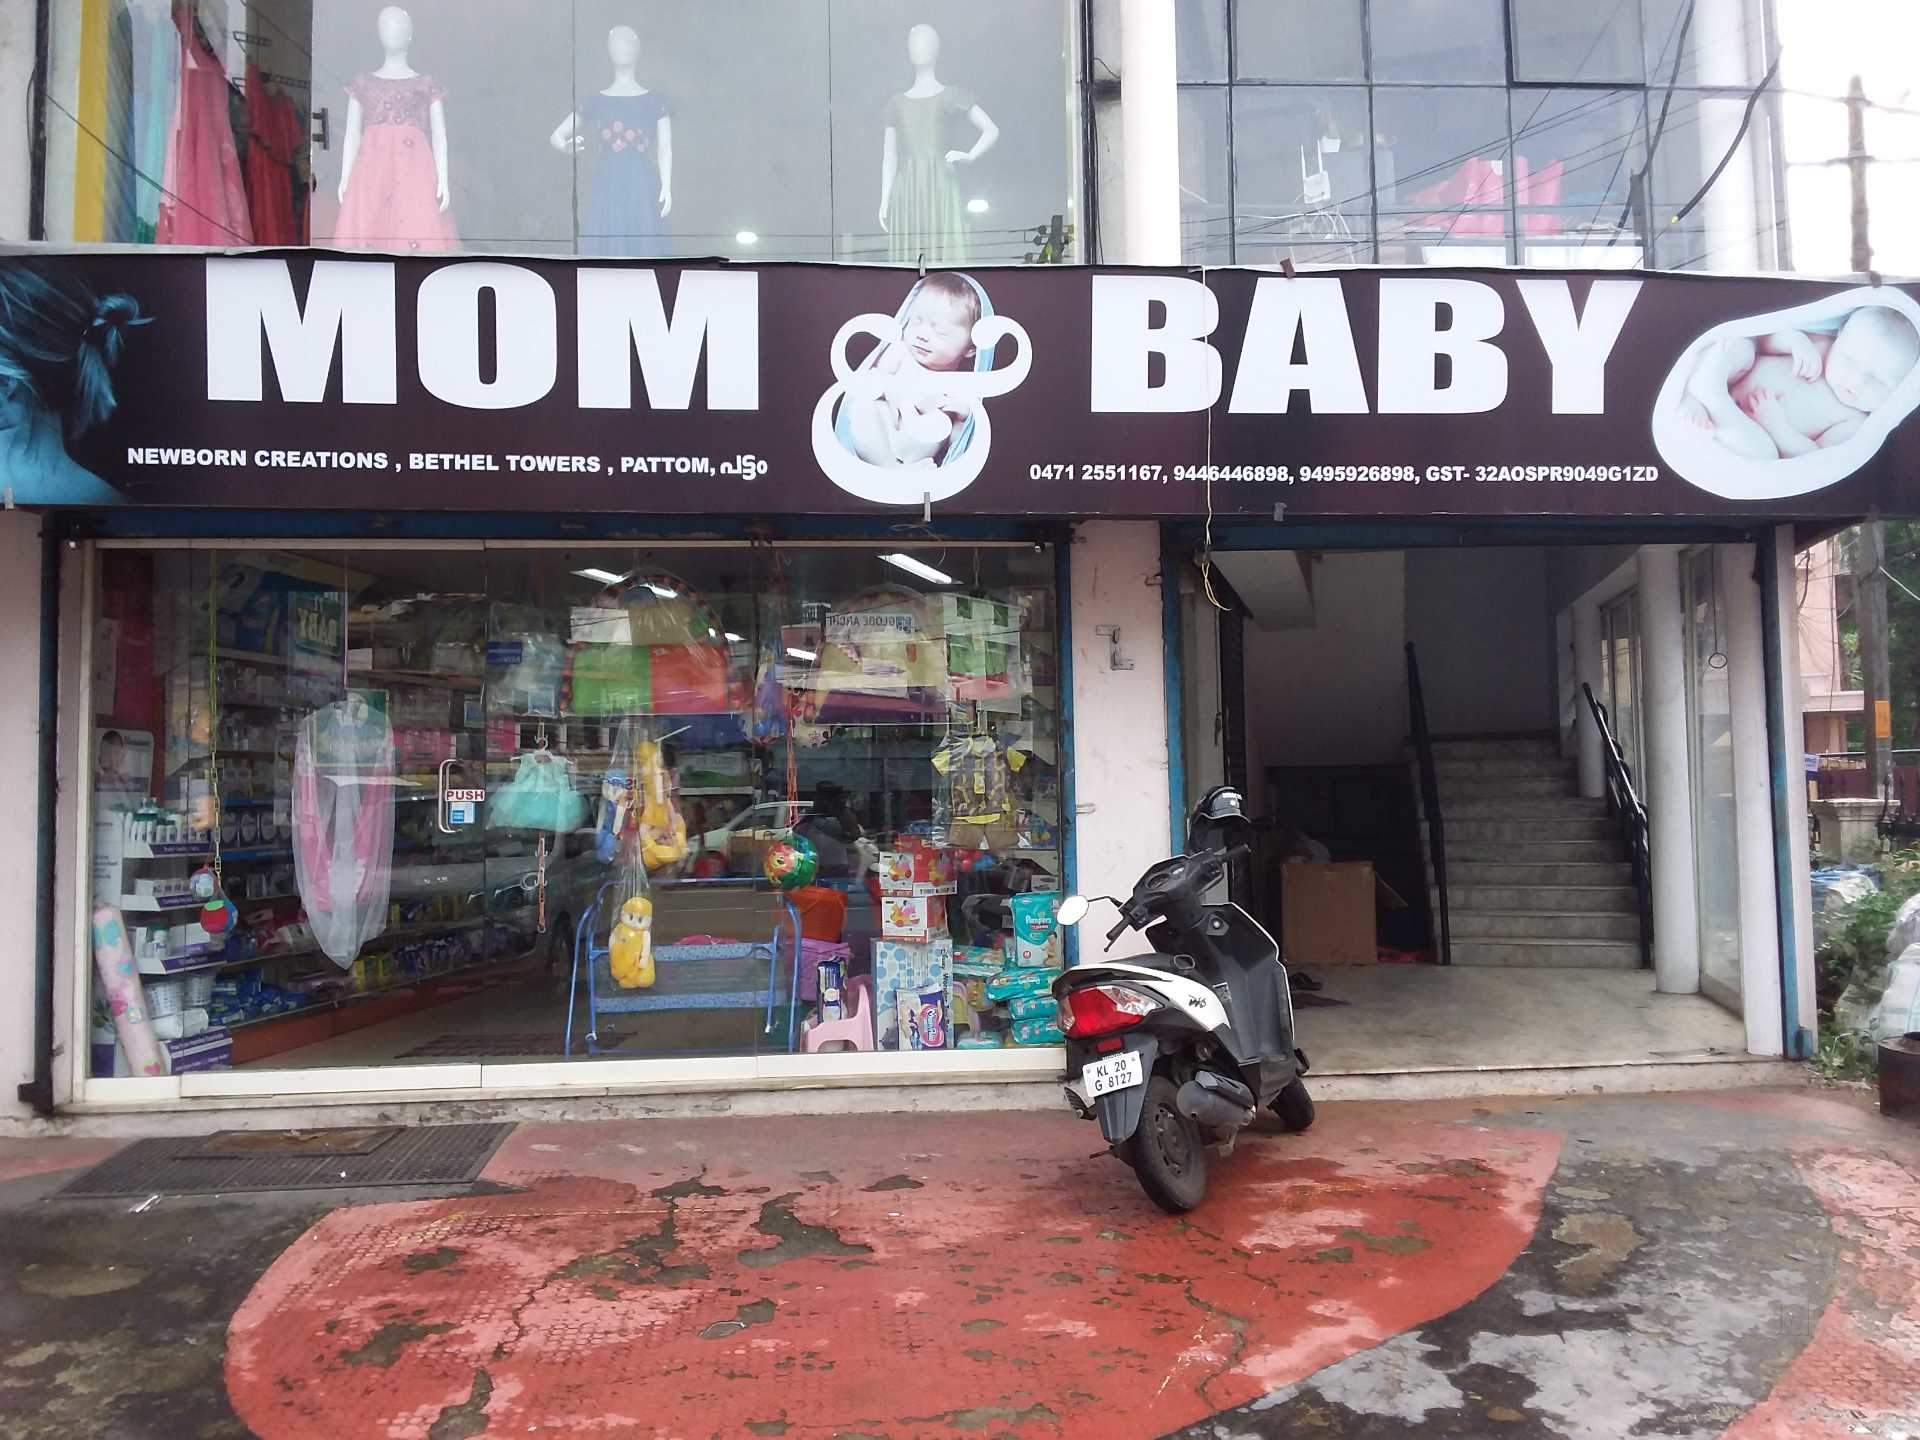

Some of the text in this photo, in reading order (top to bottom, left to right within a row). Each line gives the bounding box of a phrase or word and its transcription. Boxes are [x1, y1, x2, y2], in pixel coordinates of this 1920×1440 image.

[206, 257, 759, 410] MOM
[1091, 275, 1643, 414] BABY
[128, 448, 247, 466] NEWBORN
[254, 451, 388, 469] CREATIONS
[409, 453, 499, 471] BETHEL
[505, 455, 601, 472] TOWERS
[621, 456, 716, 476] PATTOM,
[1029, 464, 1074, 480] 0471
[1081, 465, 1167, 484] 2551167,
[1173, 465, 1294, 485] 9446446898,
[1300, 465, 1420, 484] 9495926898,
[1425, 466, 1470, 481] GST-
[446, 790, 484, 801] PUSH
[1025, 915, 1052, 925] Pampers
[1097, 1060, 1127, 1077] KL 20
[1095, 1072, 1132, 1091] G 8127
